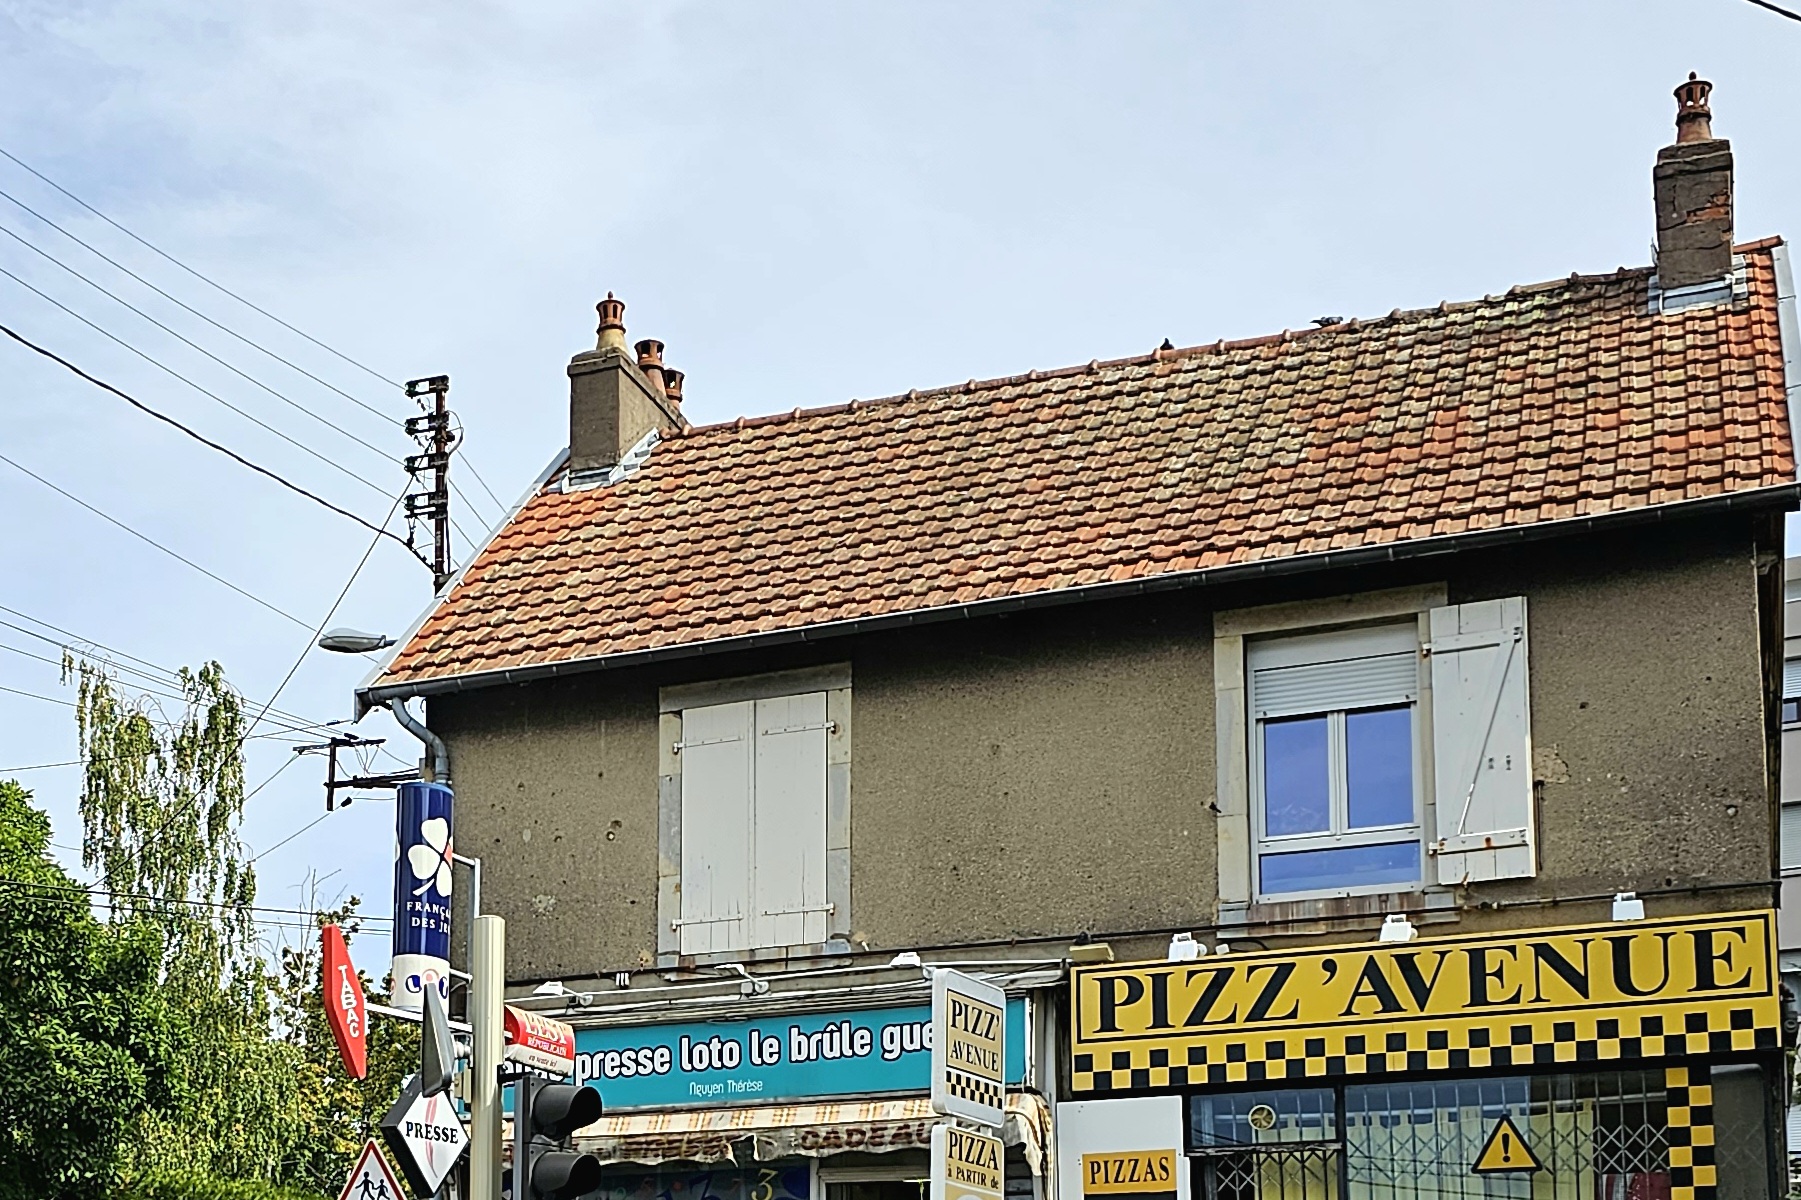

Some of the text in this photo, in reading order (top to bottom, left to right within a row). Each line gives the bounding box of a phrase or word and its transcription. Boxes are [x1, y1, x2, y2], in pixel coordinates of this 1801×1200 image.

[411, 916, 436, 929] DES
[337, 964, 360, 1039] TABAC
[524, 1013, 568, 1045] L'EST
[950, 998, 1000, 1042] PIZZ'
[527, 1036, 567, 1057] RÉPUBLICAIN
[575, 1045, 671, 1087] presse
[680, 1036, 740, 1071] loto
[750, 1030, 778, 1065] le
[790, 1021, 871, 1061] brûle
[882, 1022, 932, 1060] gue
[950, 1039, 999, 1073] AVENUE
[689, 1078, 763, 1098] Nguyen Thérèse
[405, 1119, 459, 1144] PRESSE
[800, 1121, 948, 1151] CADEAU
[947, 1130, 999, 1171] PIZZA
[947, 1163, 999, 1190] à PARTIR de
[1089, 1156, 1170, 1185] PIZZAS
